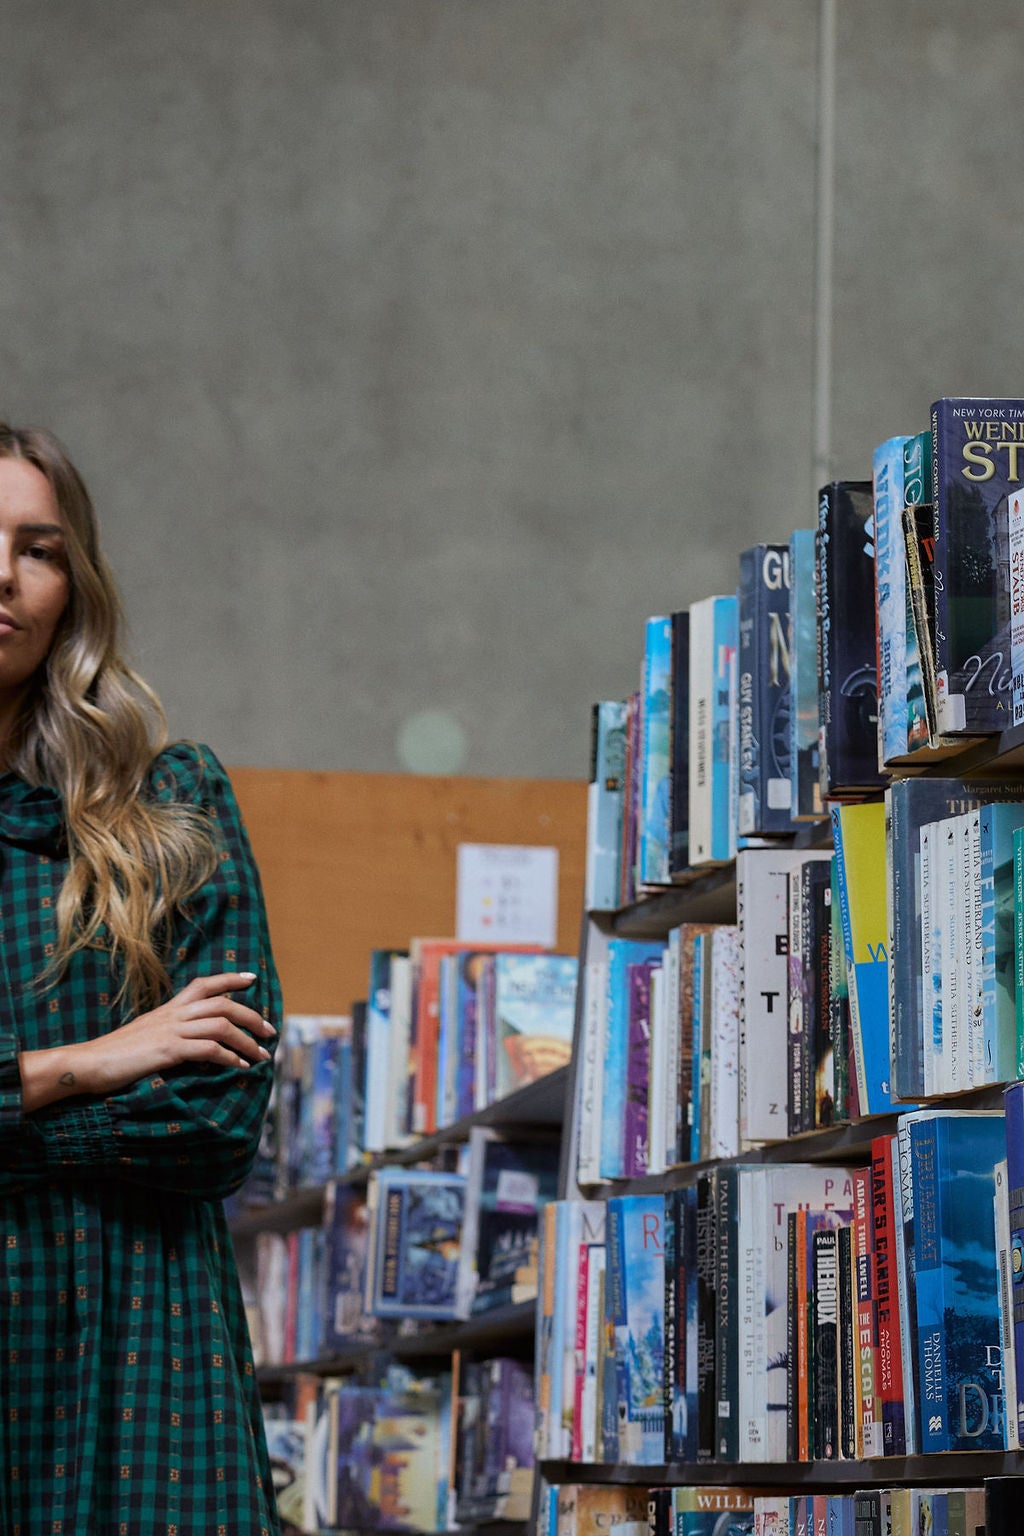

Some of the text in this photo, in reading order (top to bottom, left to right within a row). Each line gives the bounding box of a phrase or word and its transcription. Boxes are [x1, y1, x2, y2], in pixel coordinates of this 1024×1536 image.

[952, 408, 976, 417] NEW
[978, 408, 1006, 417] YORK
[876, 464, 891, 607] VODKA
[1012, 552, 1020, 616] STAUB
[741, 672, 752, 770] GUY STANLEY
[973, 837, 982, 949] TITIA SUTHERLAND
[836, 832, 844, 888] william
[842, 892, 851, 952] sutcliffe
[848, 975, 856, 991] the
[854, 1032, 864, 1089] hexagon
[967, 971, 973, 986] An
[981, 876, 994, 1007] FLYING
[900, 1127, 910, 1218] THOMAS
[914, 1138, 936, 1263] DRUMBEAT
[697, 1208, 706, 1280] HISTORY
[718, 1180, 729, 1327] PAUL THEROUX
[816, 1248, 836, 1325] THEROUX
[873, 1158, 890, 1322] LIAR'S CANDLE
[745, 1248, 754, 1376] blinding light
[856, 1179, 872, 1424] ADAM THIRLWELL THE ESCAPE
[698, 1322, 706, 1391] THEROUX
[705, 1338, 713, 1371] PAUL
[925, 1337, 933, 1400] THOMAS
[933, 1332, 941, 1402] DANIELLE
